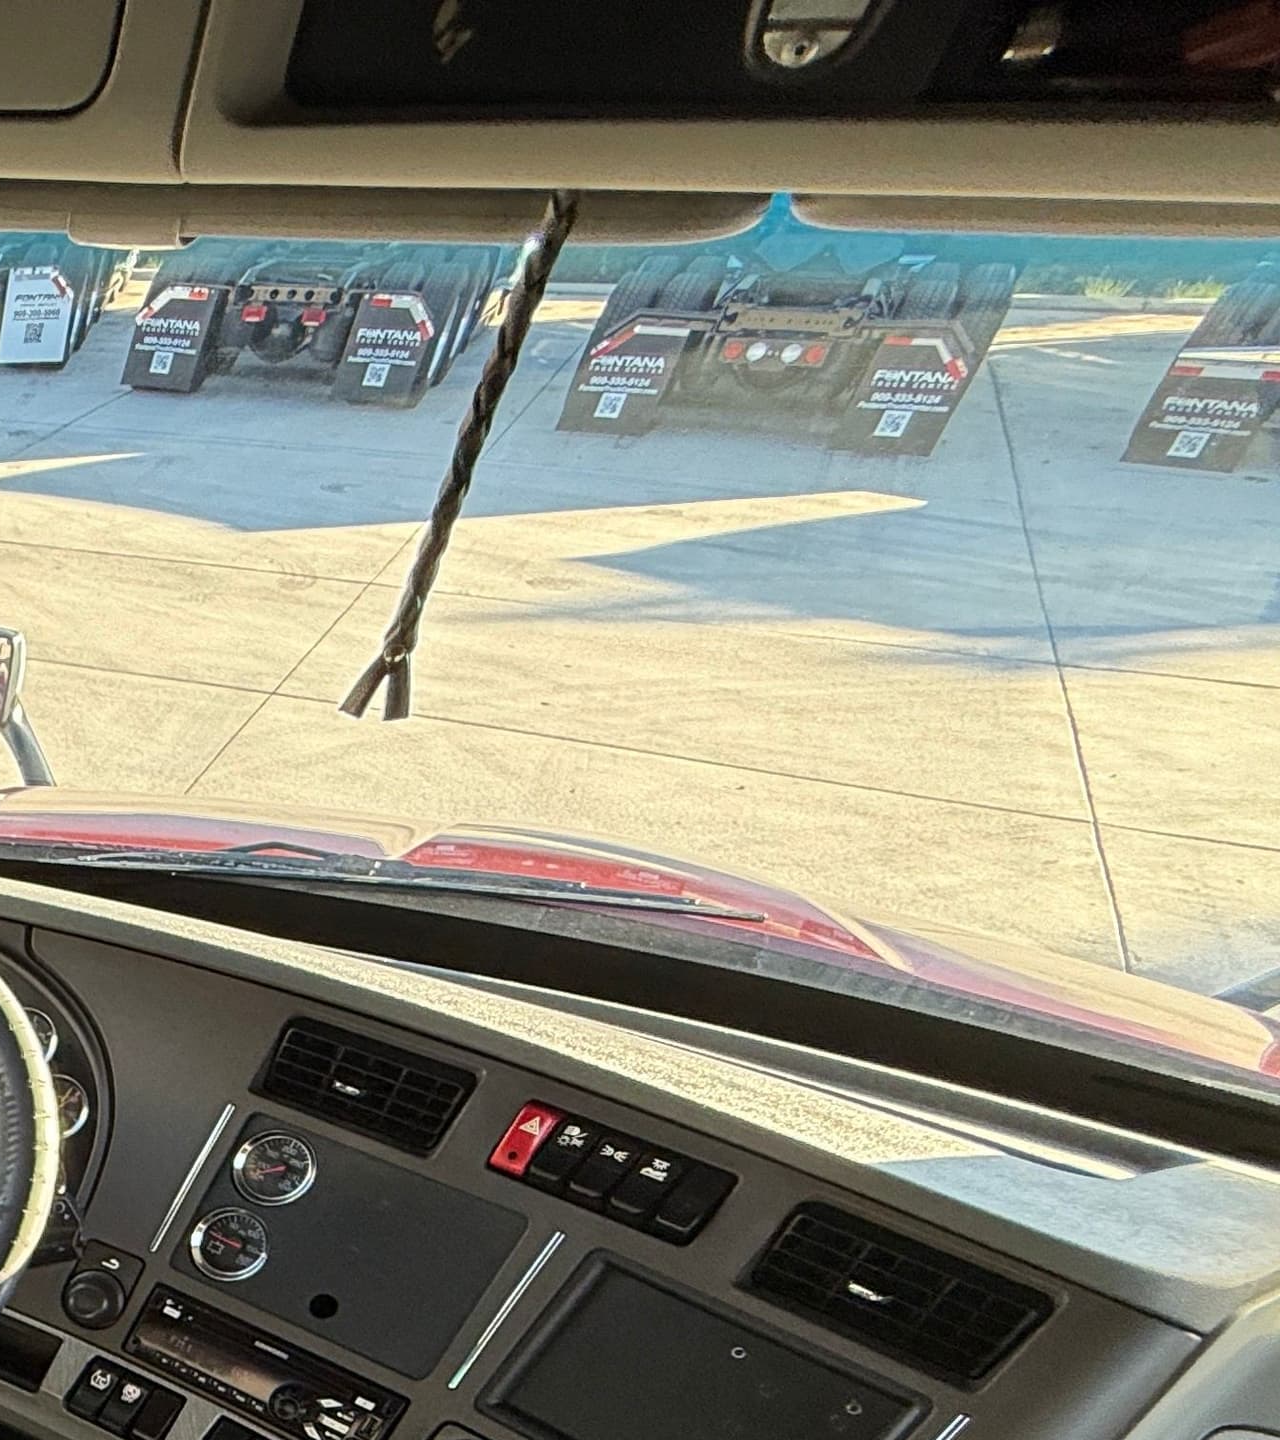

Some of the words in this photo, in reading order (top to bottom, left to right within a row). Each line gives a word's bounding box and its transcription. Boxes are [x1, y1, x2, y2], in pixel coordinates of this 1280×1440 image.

[143, 318, 199, 330] FONTANA
[357, 328, 420, 341] FONTANA
[590, 355, 665, 369] FONTANA
[1162, 396, 1259, 413] FONTANA
